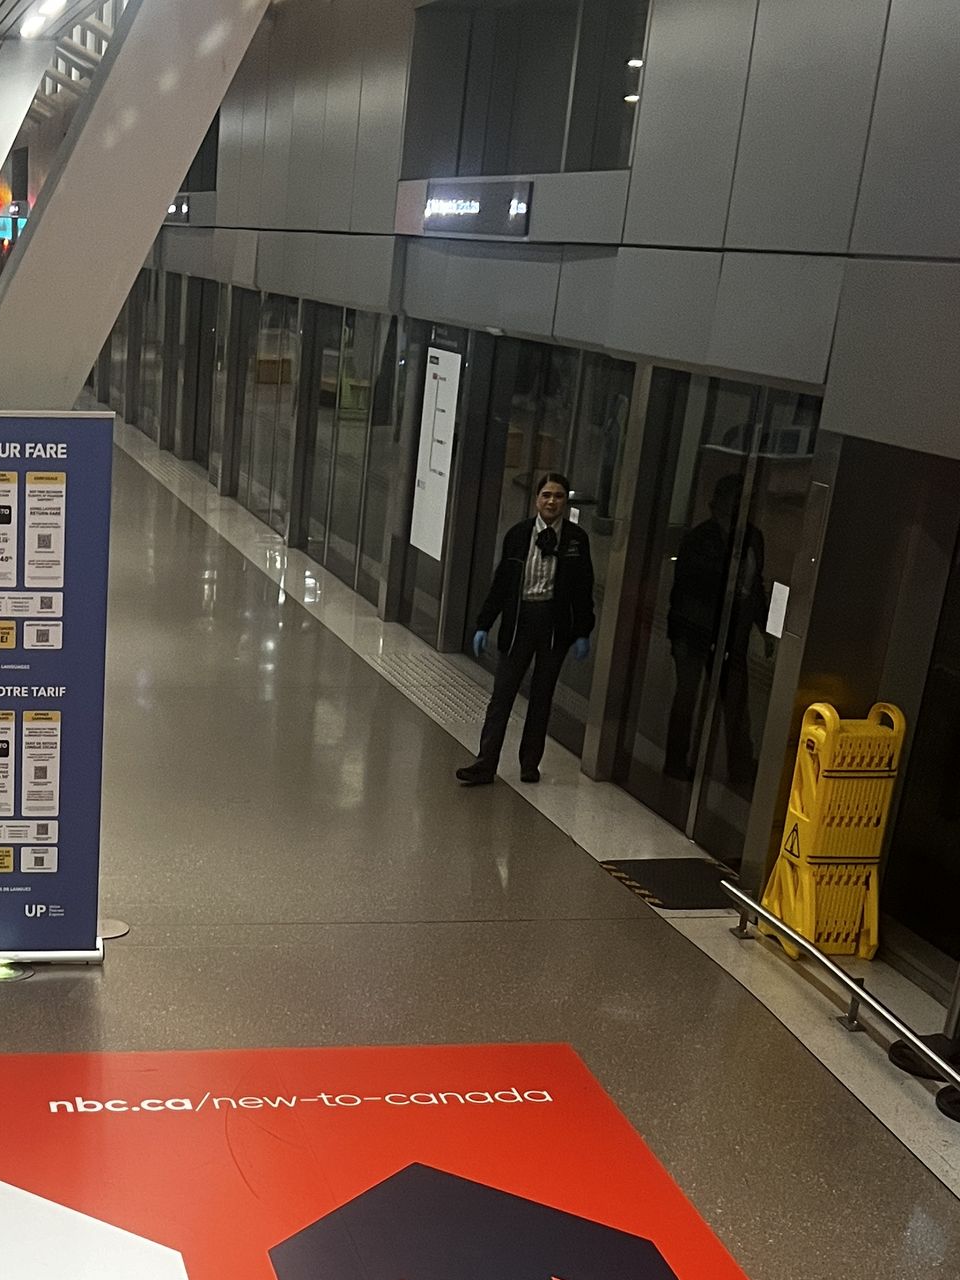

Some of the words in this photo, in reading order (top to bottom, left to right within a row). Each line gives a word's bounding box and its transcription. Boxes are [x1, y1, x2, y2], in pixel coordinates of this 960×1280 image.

[25, 443, 67, 458] FARE
[31, 686, 66, 697] TARIF
[25, 904, 46, 917] UP
[48, 1088, 553, 1112] nbc.ca/new-to-canada
